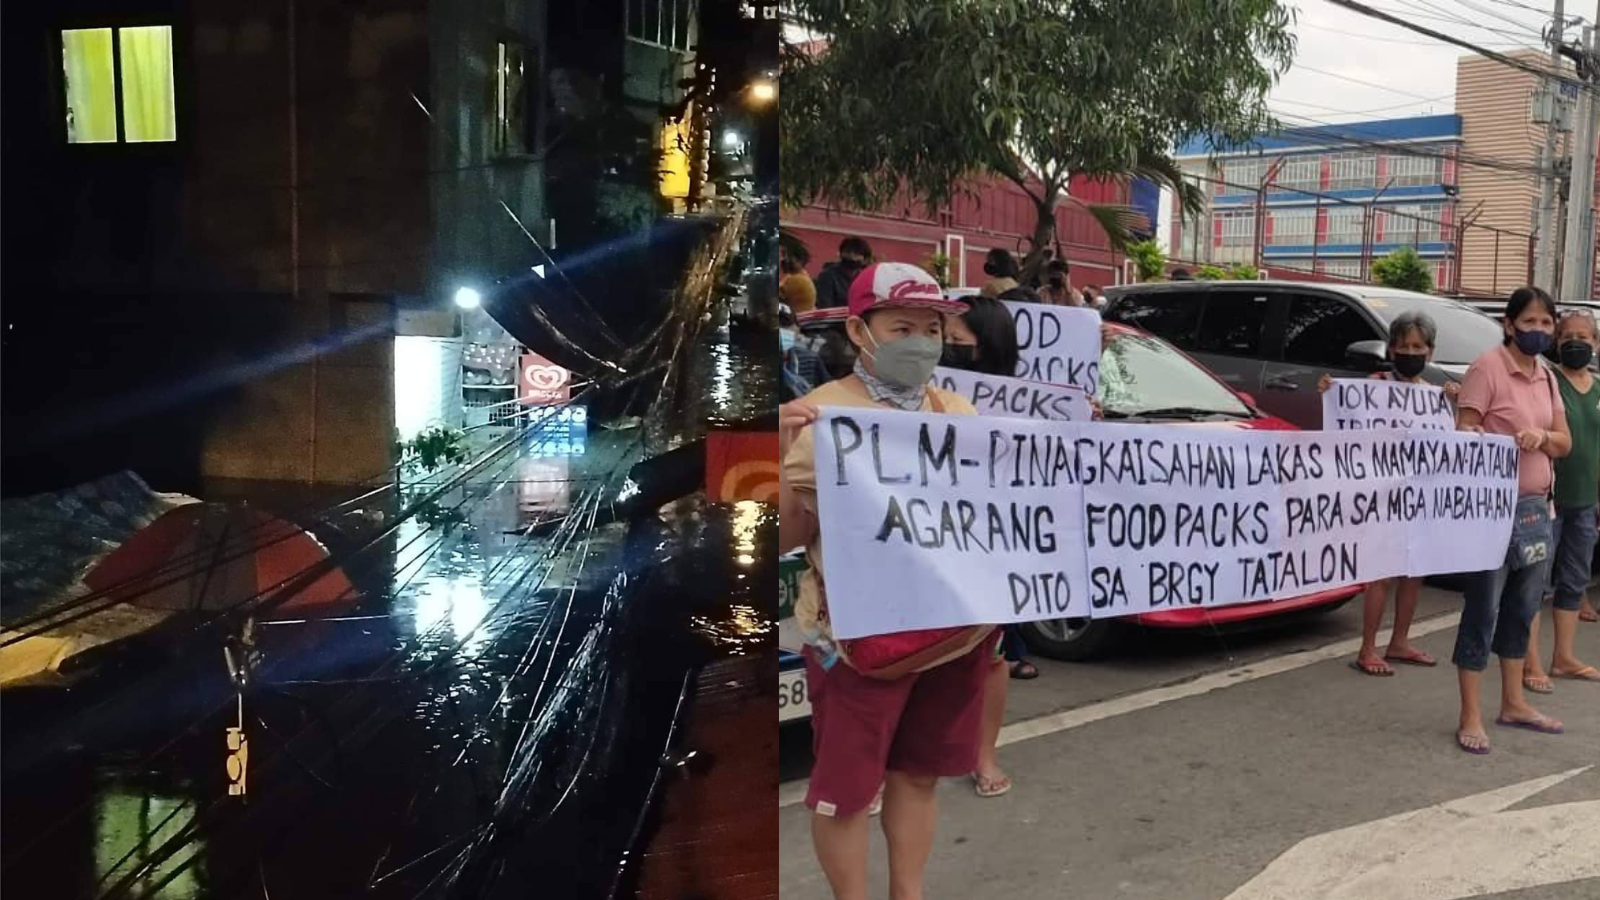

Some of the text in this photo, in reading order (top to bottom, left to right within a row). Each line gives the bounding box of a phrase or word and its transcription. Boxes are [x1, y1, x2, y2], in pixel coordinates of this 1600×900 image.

[972, 381, 1072, 421] PACKS
[1387, 385, 1451, 416] AYUDA
[1245, 443, 1324, 486] LAKAS
[1334, 443, 1366, 481] NG
[875, 495, 1057, 553] AGARANG
[1086, 503, 1166, 550] FOOD
[1175, 502, 1269, 548] PACKS
[1286, 492, 1344, 537] PARA
[1350, 489, 1380, 526] SA
[1387, 486, 1427, 523] MGA
[1524, 543, 1547, 565] 23
[1008, 542, 1358, 615] DITO SA BRGY TATALON
